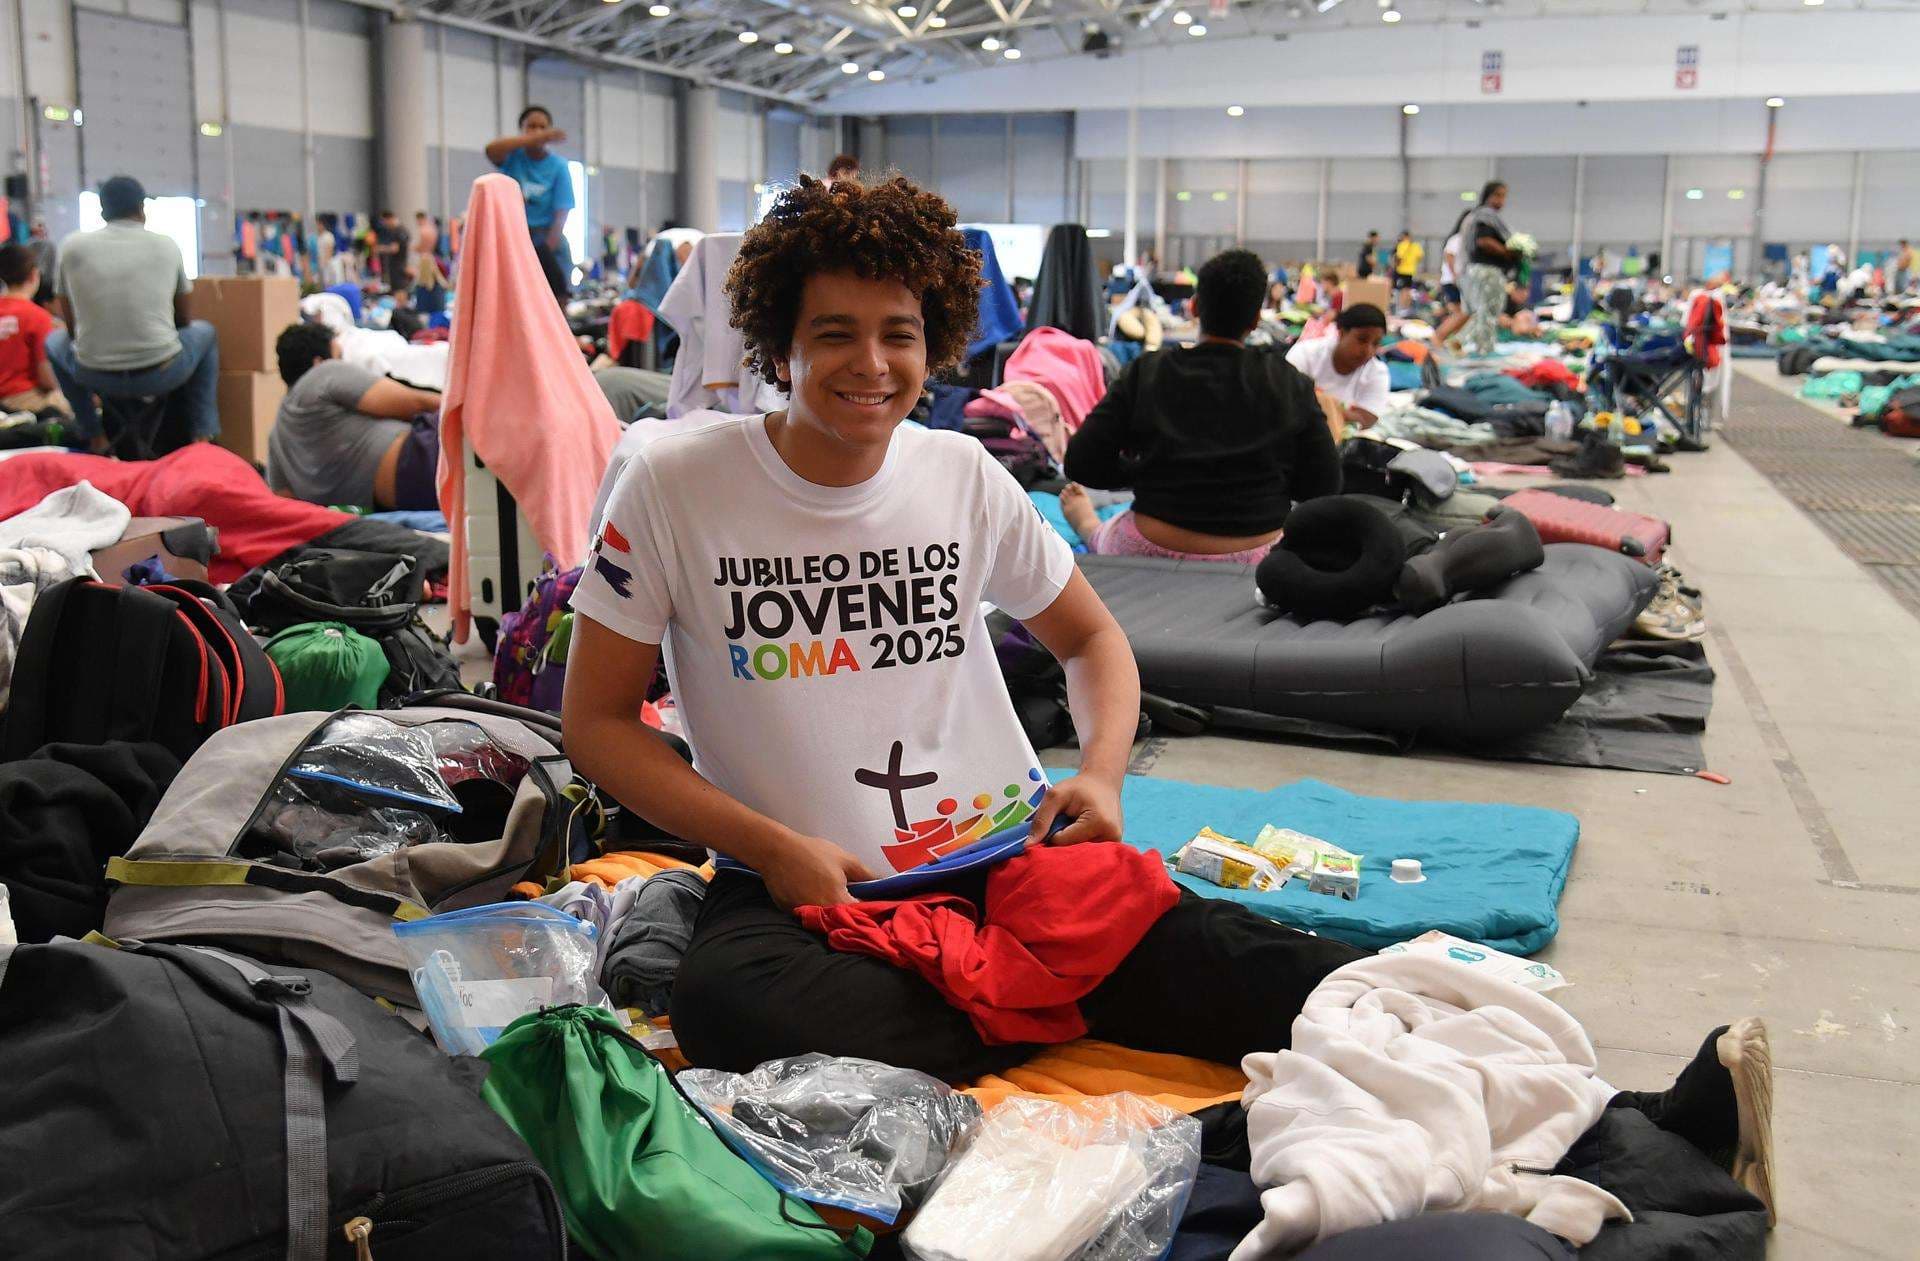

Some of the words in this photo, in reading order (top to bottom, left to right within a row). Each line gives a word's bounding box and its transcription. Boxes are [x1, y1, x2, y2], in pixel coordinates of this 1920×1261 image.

[714, 554, 850, 587] JUBILEO
[860, 549, 899, 580] DE
[908, 542, 960, 574] LOS
[728, 638, 861, 681] ROMA
[870, 624, 965, 669] 2025
